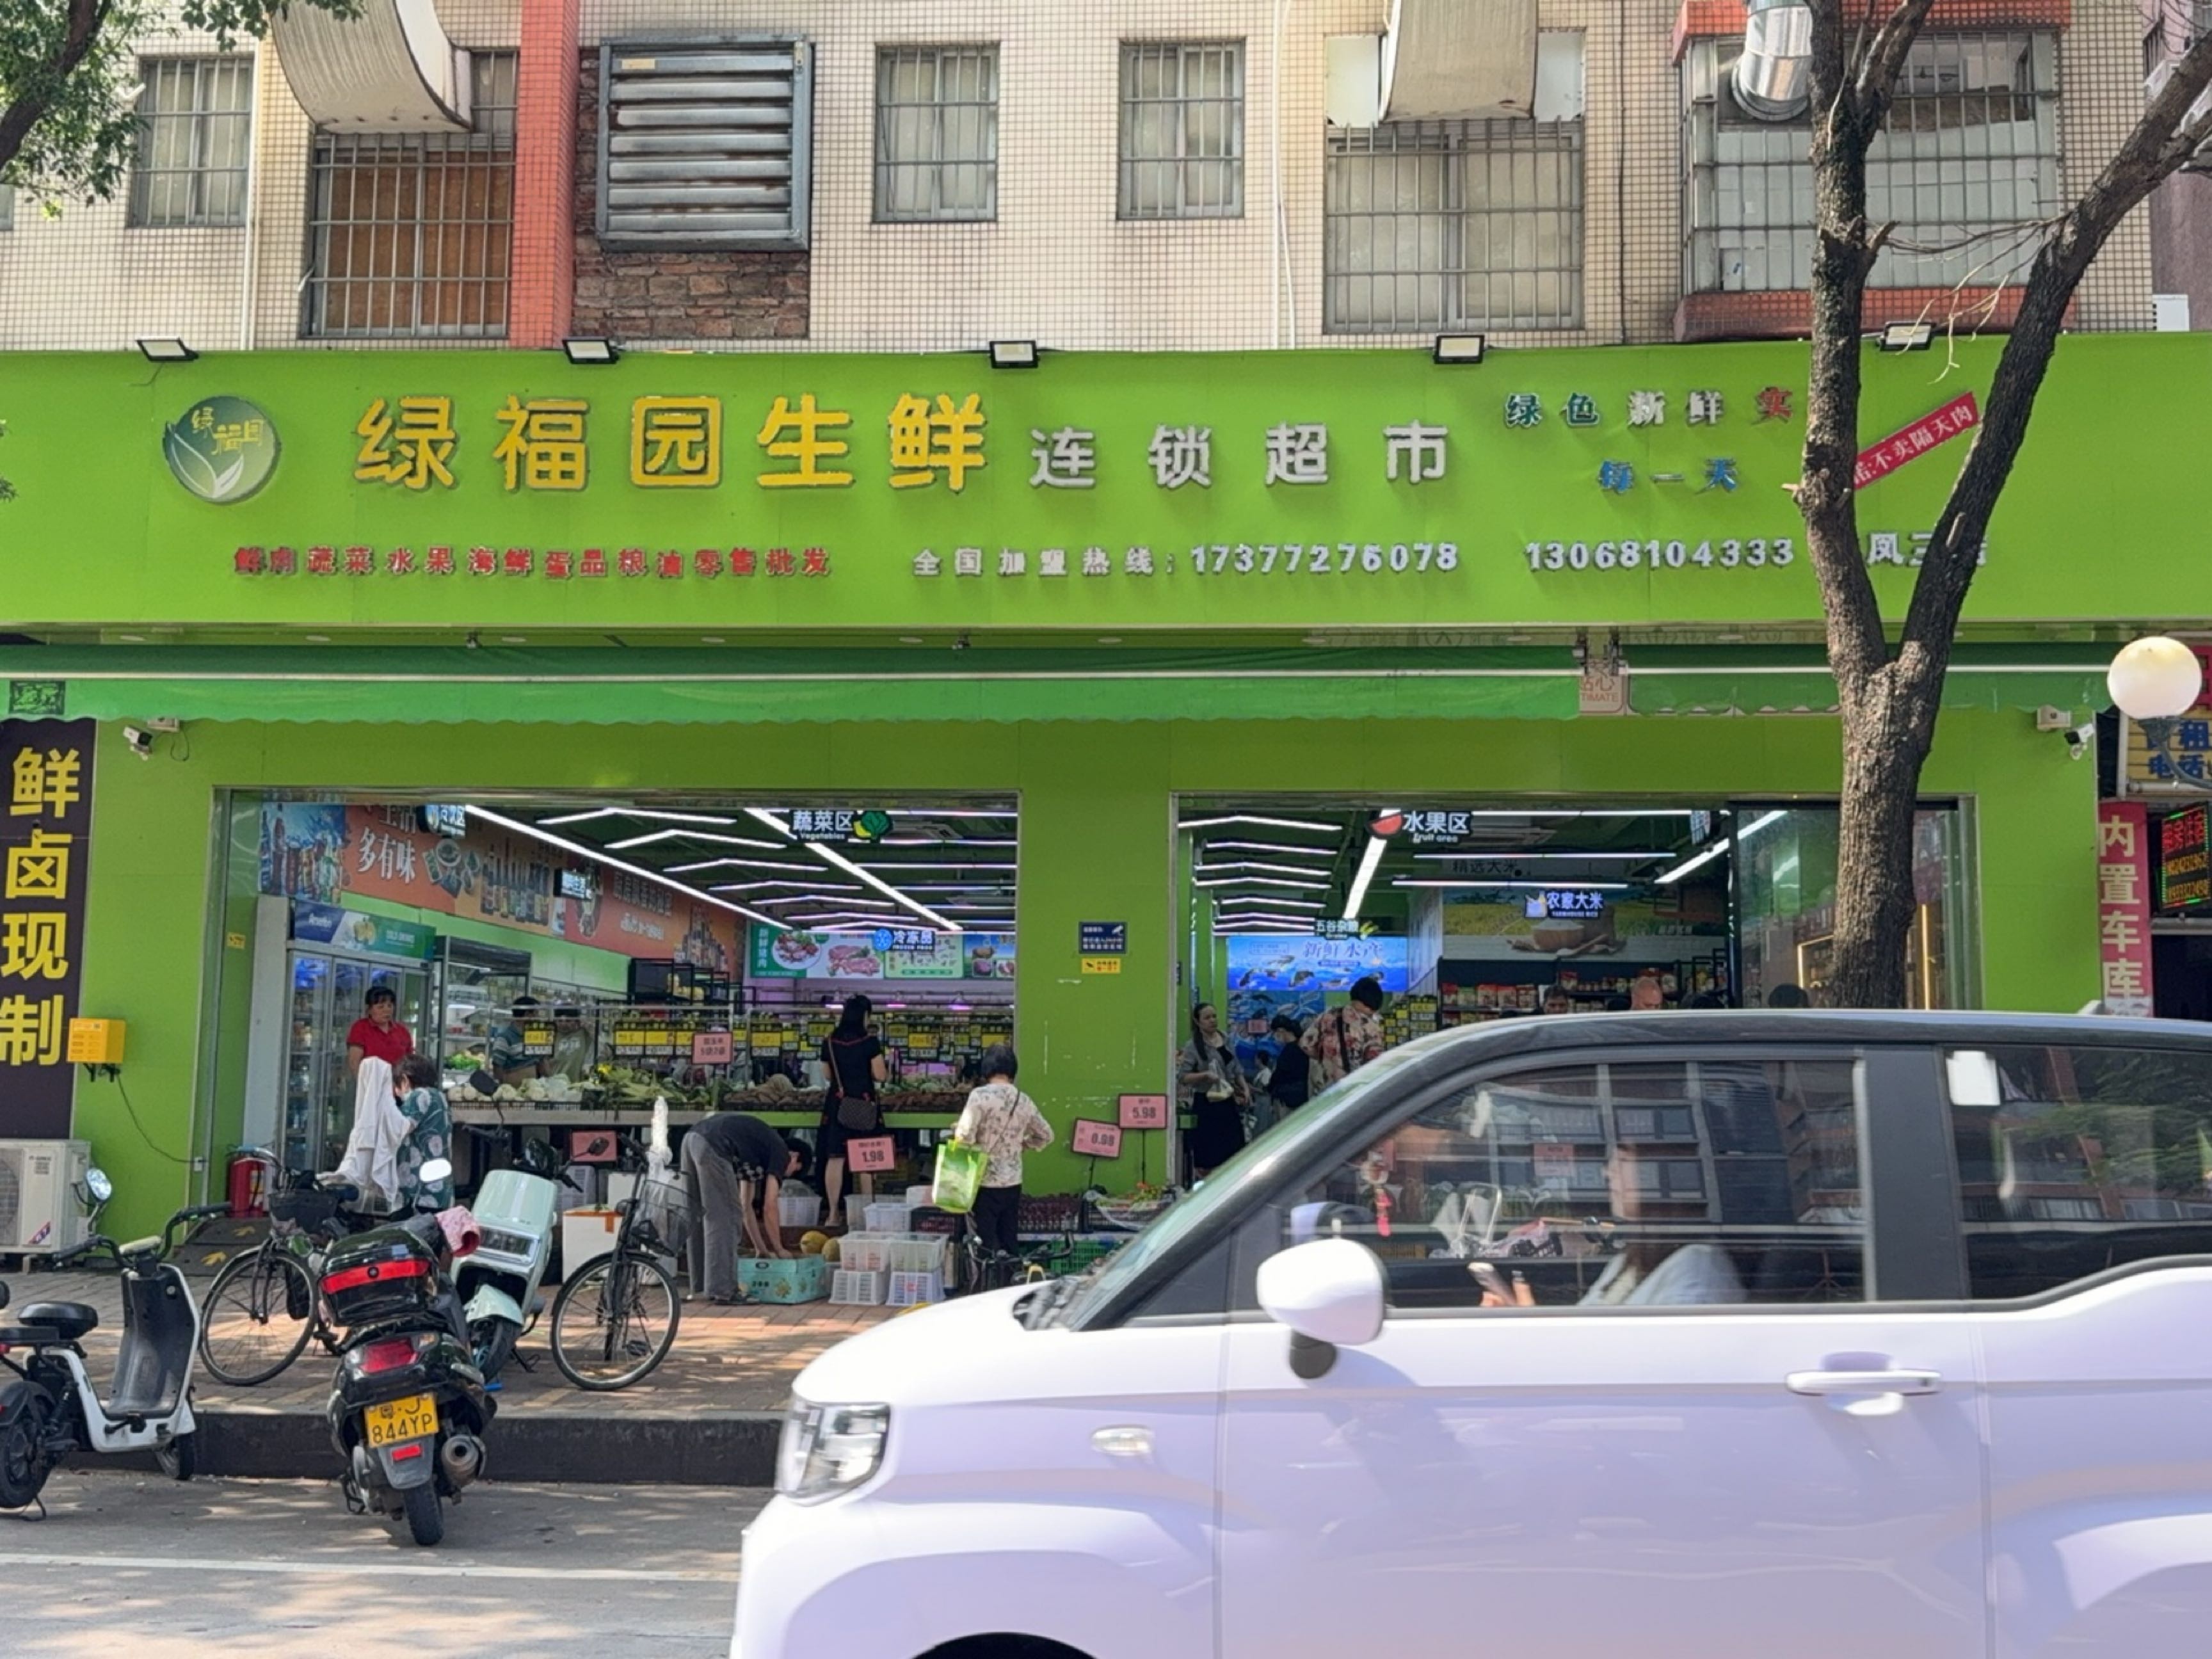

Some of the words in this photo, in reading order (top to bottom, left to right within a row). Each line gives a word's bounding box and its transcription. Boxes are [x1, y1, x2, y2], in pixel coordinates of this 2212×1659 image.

[354, 394, 984, 490] 绿福园生鲜
[1030, 420, 1448, 489] 连锁超市
[1192, 543, 1459, 573] 17377276078
[1525, 538, 1794, 570] 13068104333
[793, 810, 854, 831] 蔬菜区
[1402, 810, 1470, 833] 水果区
[358, 826, 415, 883] 多有味
[0, 747, 81, 1066] 鲜卤现制
[1546, 891, 1604, 910] 农家大米
[372, 1413, 433, 1444] 844YP
